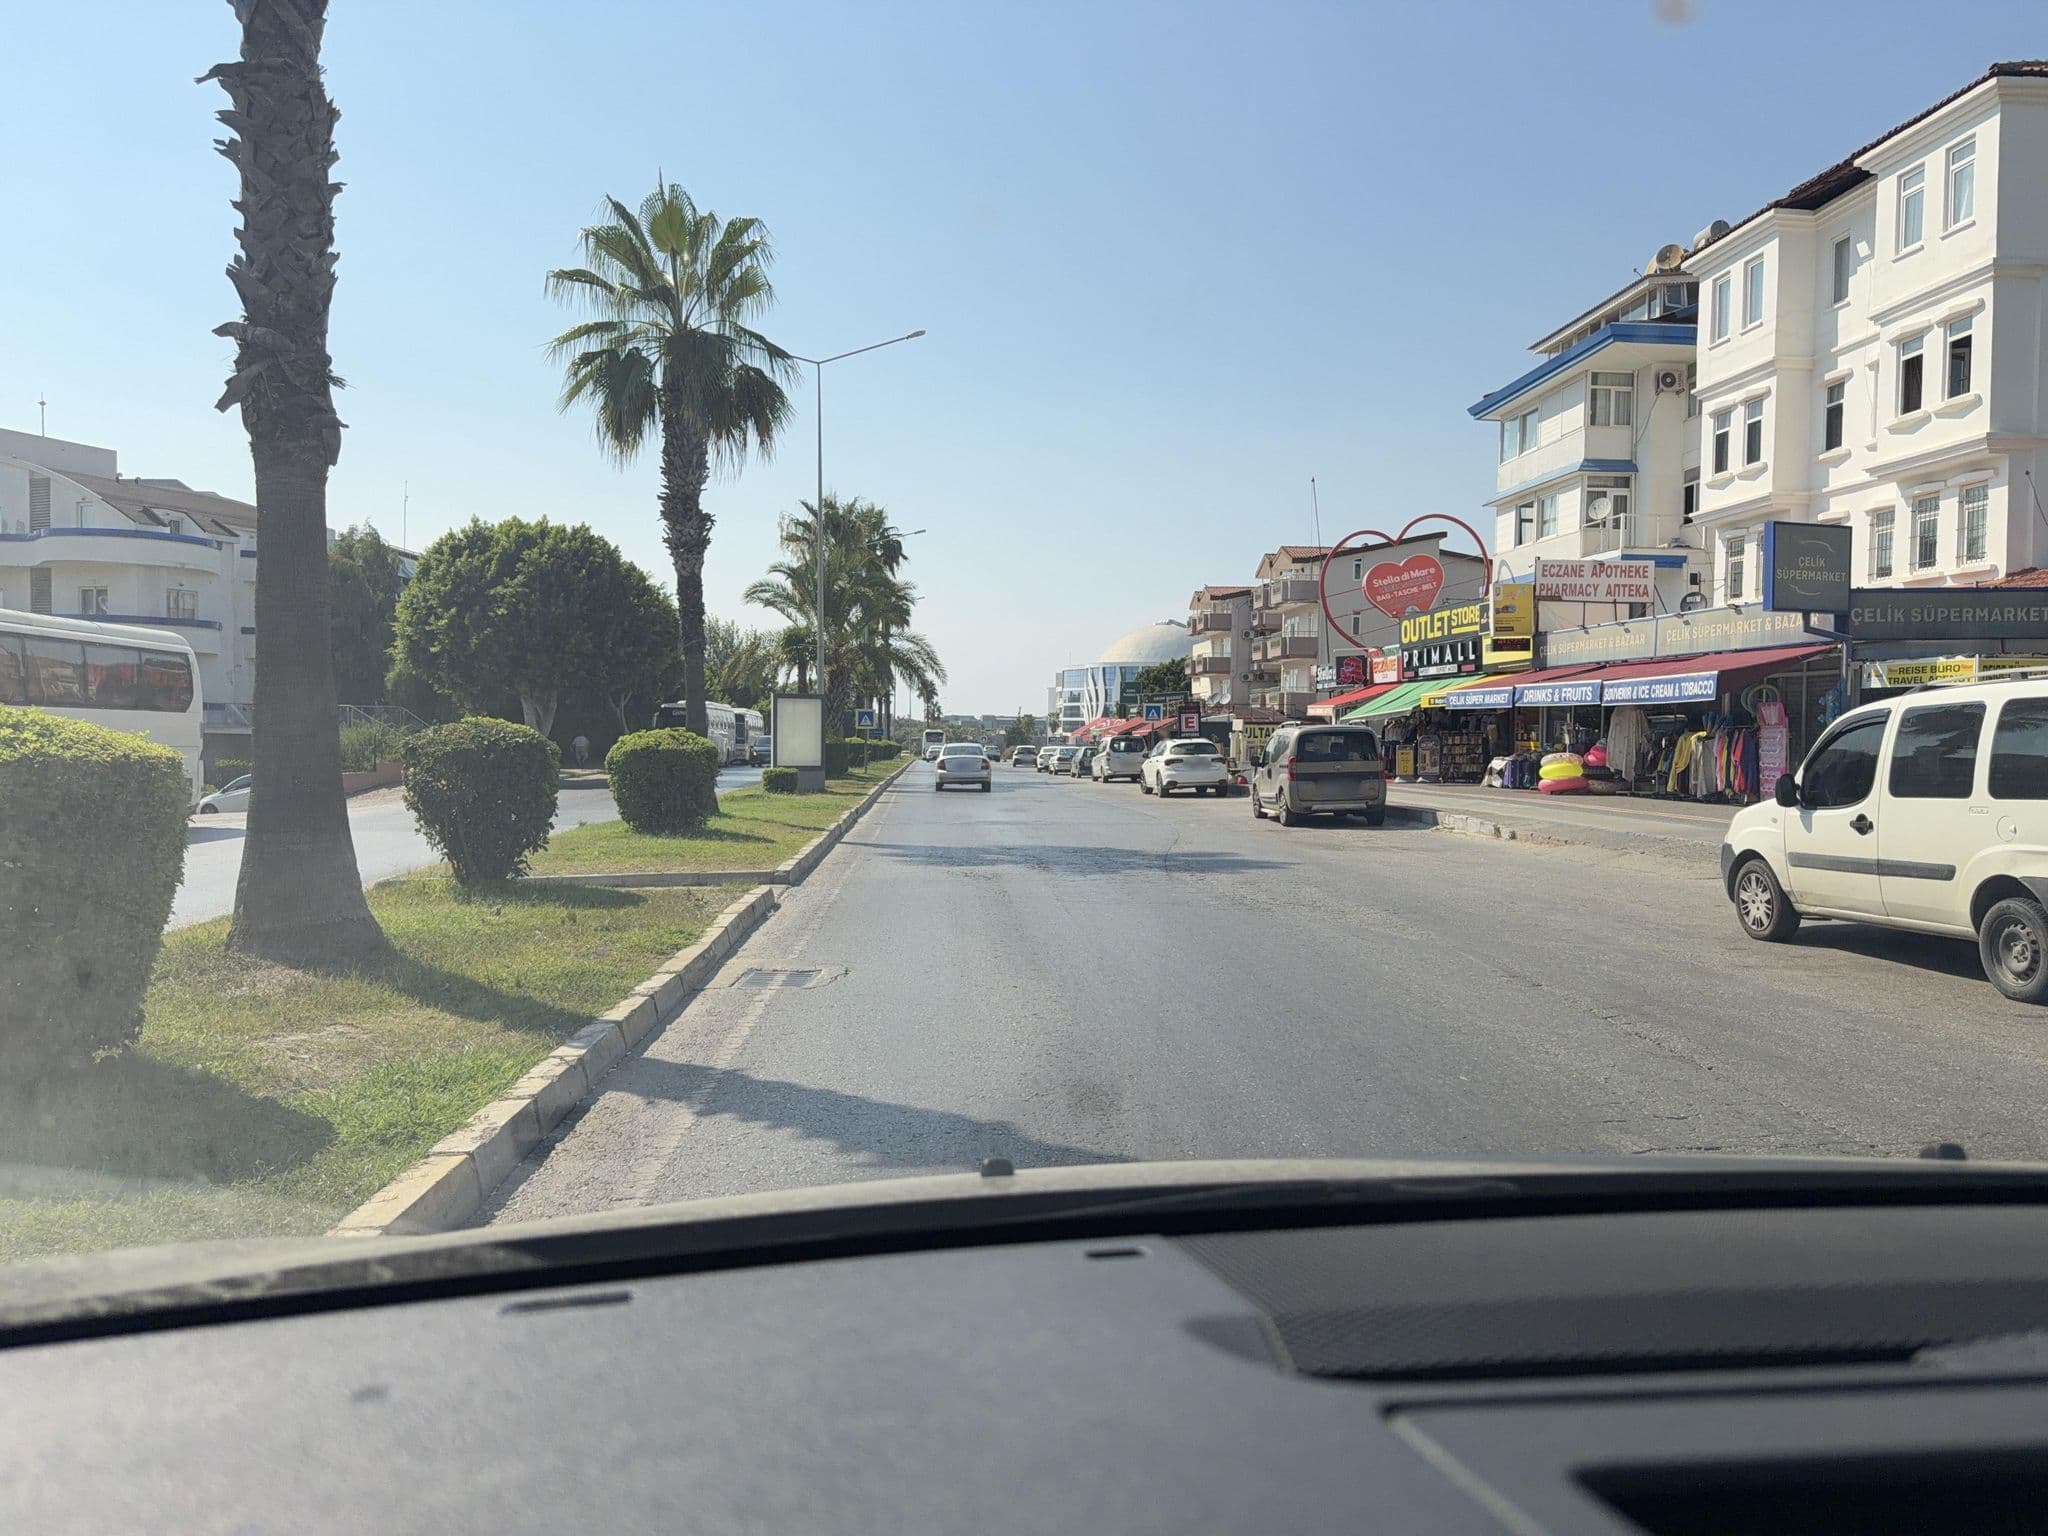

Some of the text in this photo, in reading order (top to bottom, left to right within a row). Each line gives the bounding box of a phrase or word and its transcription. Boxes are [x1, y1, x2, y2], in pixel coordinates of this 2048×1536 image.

[1372, 576, 1400, 588] Stella
[1401, 571, 1410, 581] di
[1410, 567, 1436, 578] Mare
[1541, 564, 1649, 579] ECZANE APOTHEKE
[1539, 583, 1600, 598] PHARMACY
[1605, 583, 1650, 598] АПТЕКА
[1765, 618, 1772, 631] &
[1774, 612, 1819, 629] BAZAR
[1851, 604, 2048, 625] ÇELİK SÜPERMARKET
[1401, 604, 1480, 644] OUTLET STORE
[1615, 633, 1645, 648] BAZAAR
[1403, 640, 1476, 668] PRIMALL
[1898, 664, 1928, 675] REISE
[1888, 675, 1925, 685] TRAVEL
[1485, 692, 1509, 704] MARKET
[1524, 686, 1592, 703] DRINKS & FRUITS
[1603, 686, 1632, 701] SOUVENIR
[1638, 684, 1650, 699] ICE
[1650, 683, 1674, 698] CREAM
[1674, 683, 1680, 697] &
[1681, 680, 1714, 696] TOBACCO
[1184, 716, 1195, 729] E
